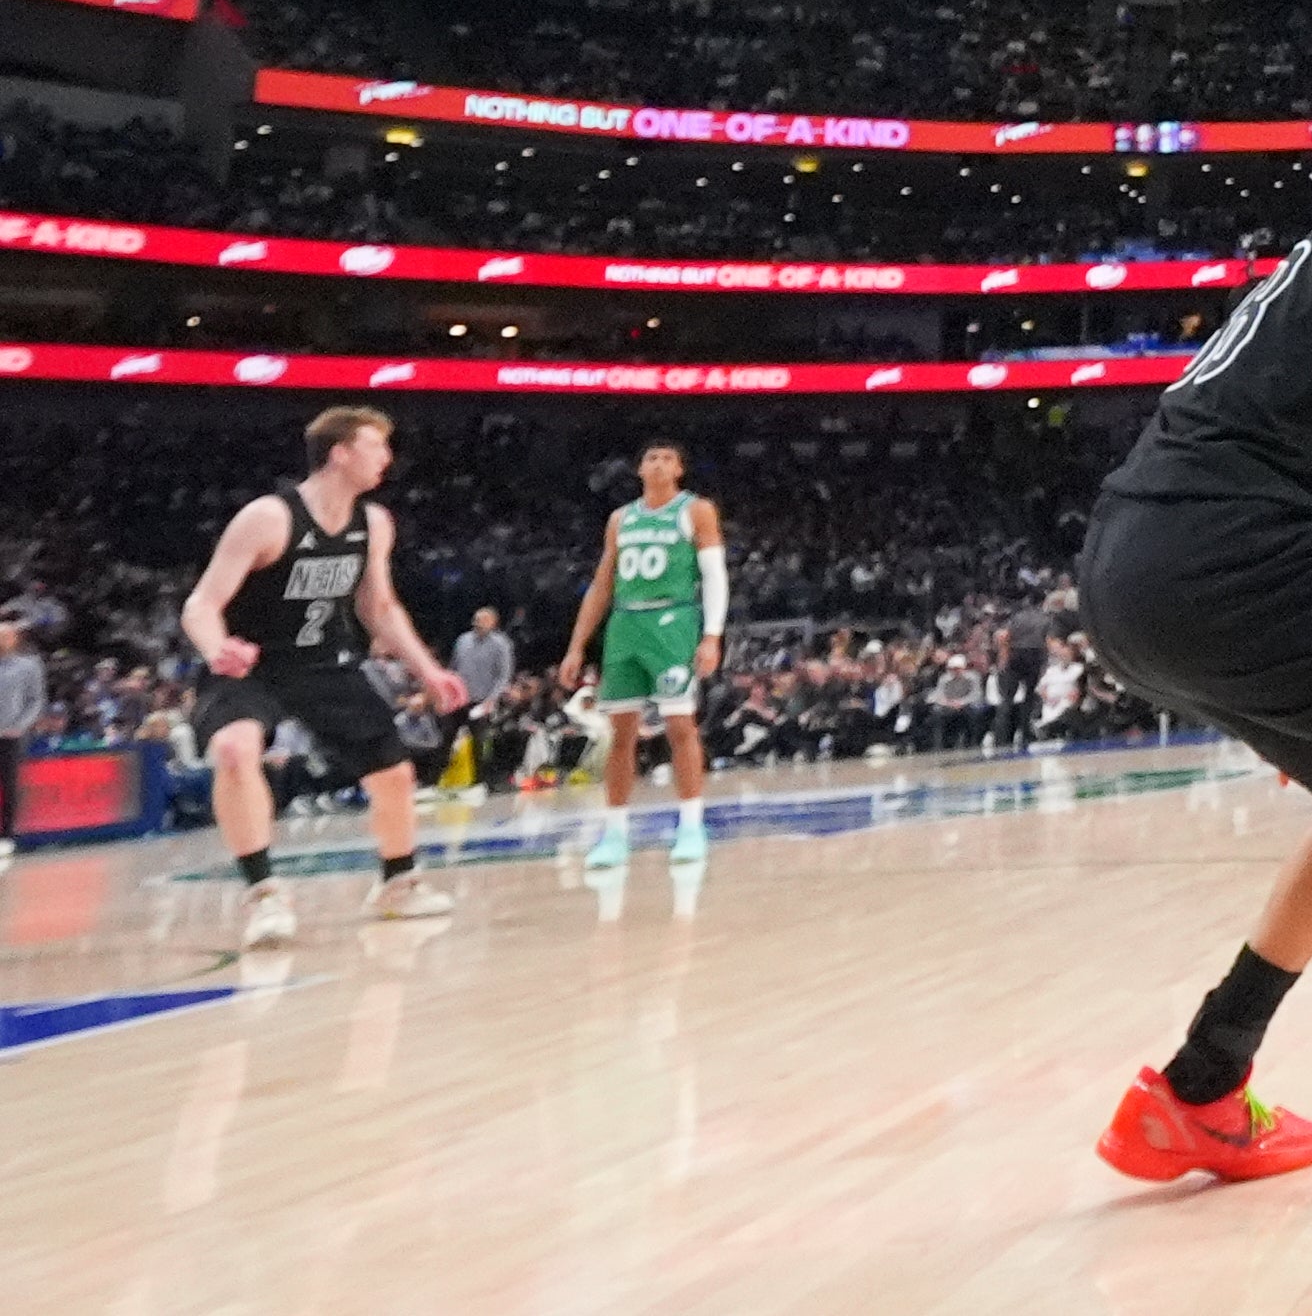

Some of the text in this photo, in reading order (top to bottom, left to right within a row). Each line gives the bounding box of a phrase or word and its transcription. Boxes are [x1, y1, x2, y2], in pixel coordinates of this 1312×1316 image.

[464, 94, 909, 147] NOTHING BUT ONE-OF-A-KIND
[605, 265, 904, 288] NOTHING BUT ONE-OF-A-KIND
[498, 368, 790, 389] NOTHING BUT ONE-OF-A-KIND
[618, 545, 667, 582] 00
[296, 599, 335, 647] 2
